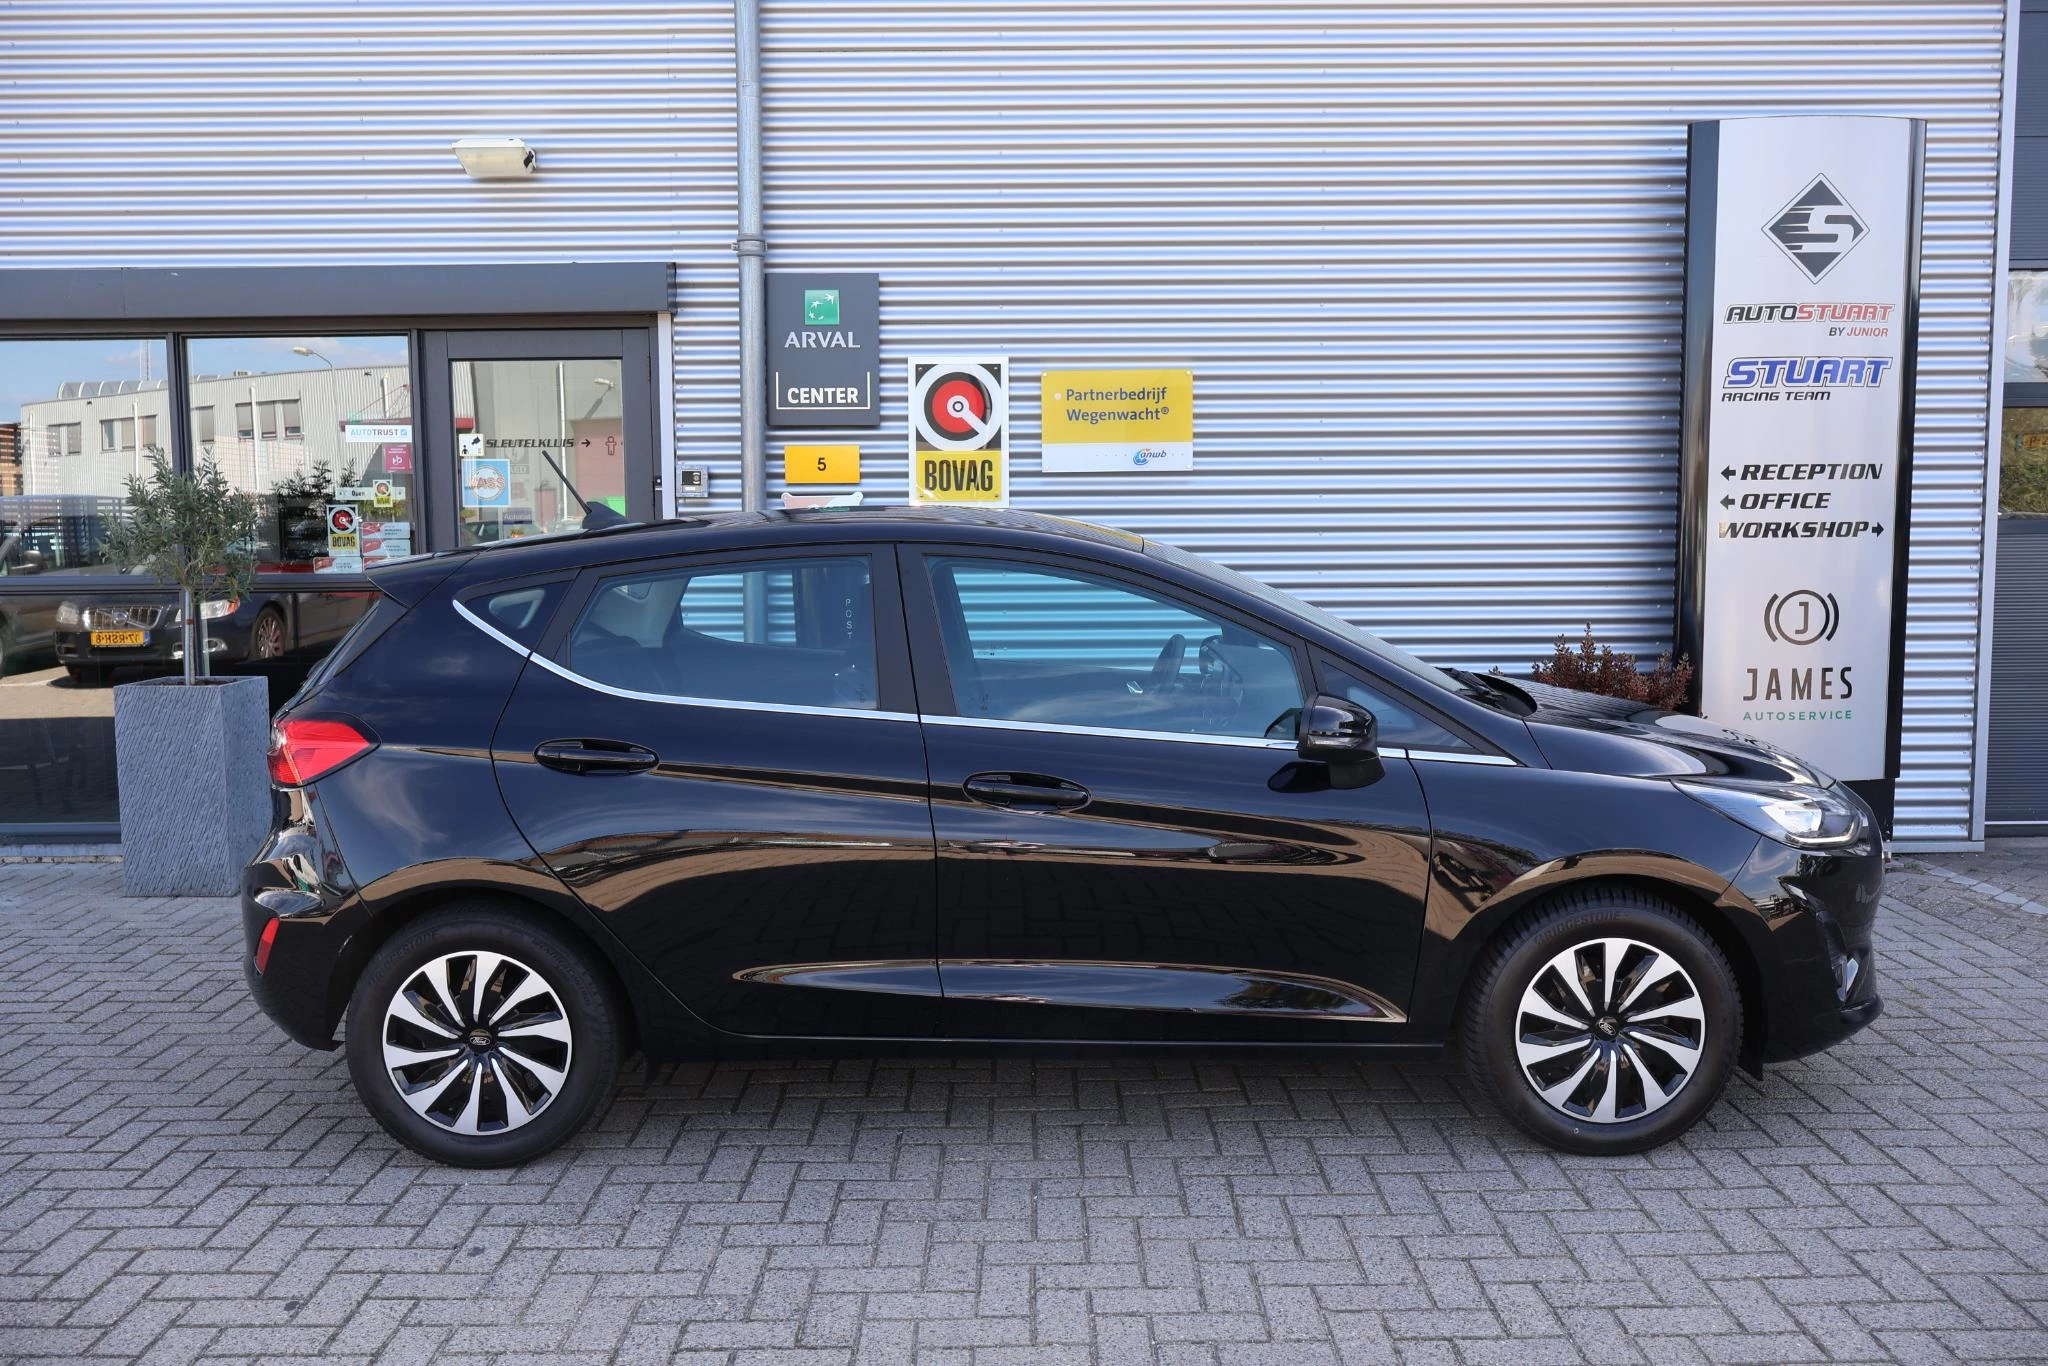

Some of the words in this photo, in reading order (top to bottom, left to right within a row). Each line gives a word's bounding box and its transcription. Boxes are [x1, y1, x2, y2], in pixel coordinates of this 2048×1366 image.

[1725, 303, 1894, 323] AUTOSTUART
[784, 331, 861, 349] ARVAL
[1829, 327, 1845, 337] BY
[1847, 327, 1889, 337] JUNIOR
[1725, 356, 1893, 387] STUART
[787, 387, 859, 404] CENTER
[1066, 387, 1167, 403] Partnerbedrijf
[1721, 391, 1780, 403] RACING
[1785, 391, 1831, 402] TEAM
[350, 428, 398, 437] AUTOTRUST
[485, 438, 575, 448] SLEUTELKLUIS
[1140, 450, 1167, 459] anwb
[817, 457, 827, 471] 5
[1740, 463, 1883, 481] RECEPTION
[924, 459, 994, 491] BOVAG
[1740, 492, 1831, 510] OFFICE
[1718, 521, 1870, 539] WORKSHOP
[1743, 666, 1853, 701] JAMES
[1743, 709, 1853, 721] AUTOSERVICE
